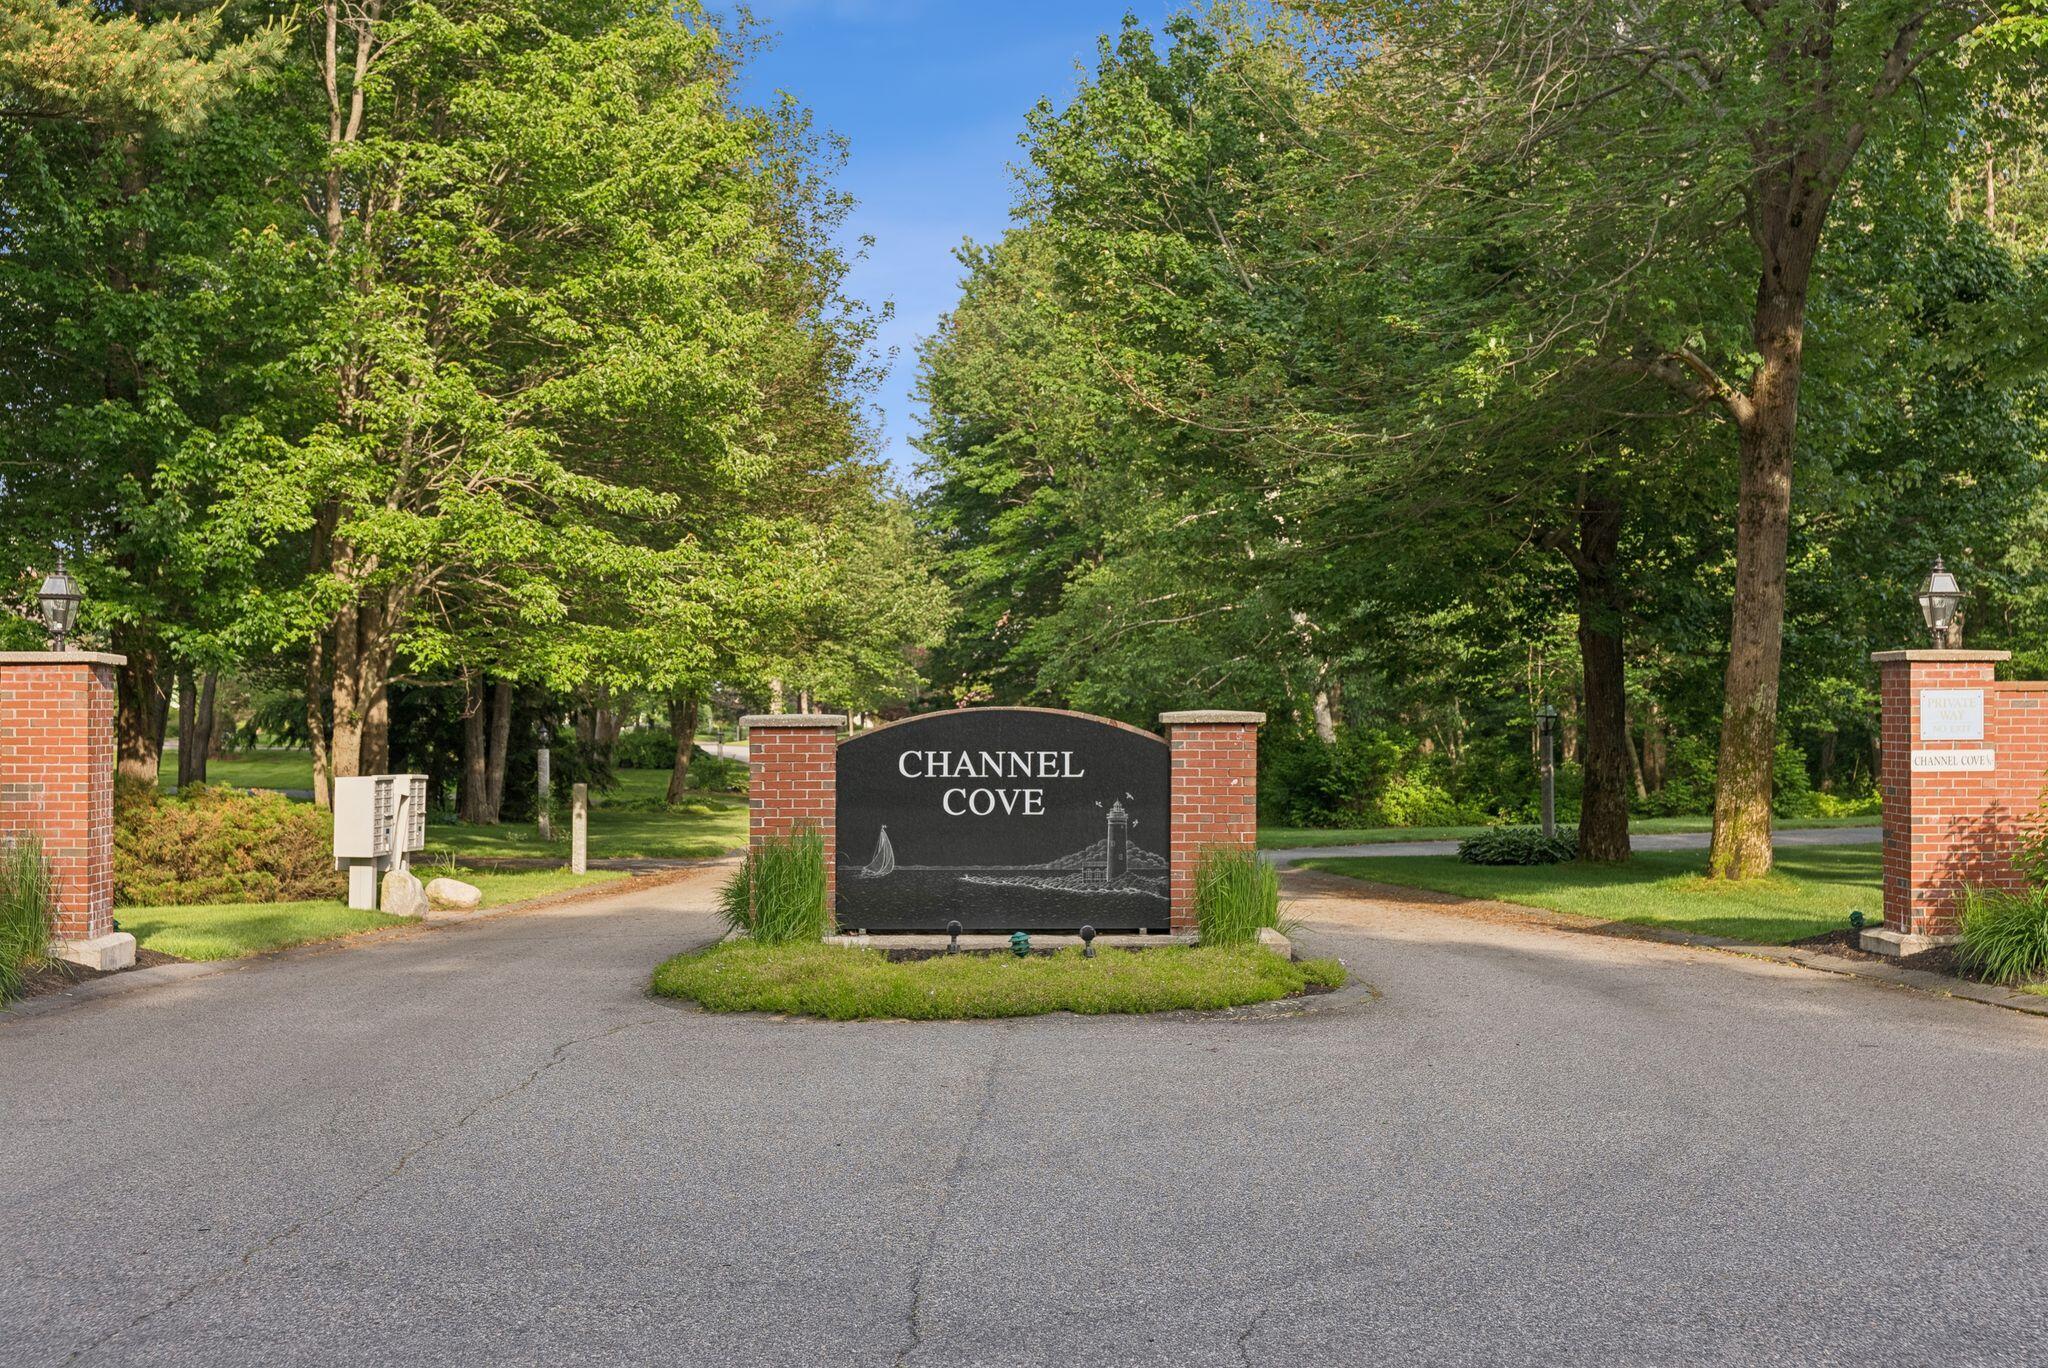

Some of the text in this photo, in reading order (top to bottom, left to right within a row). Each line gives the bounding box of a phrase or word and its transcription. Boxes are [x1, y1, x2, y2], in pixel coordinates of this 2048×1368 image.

[1927, 697, 1977, 708] PRIVATE
[1939, 710, 1964, 720] WAY
[898, 750, 1085, 778] CHANNEL
[1914, 755, 1985, 766] CHANNEL COVE
[942, 788, 1046, 816] COVE
